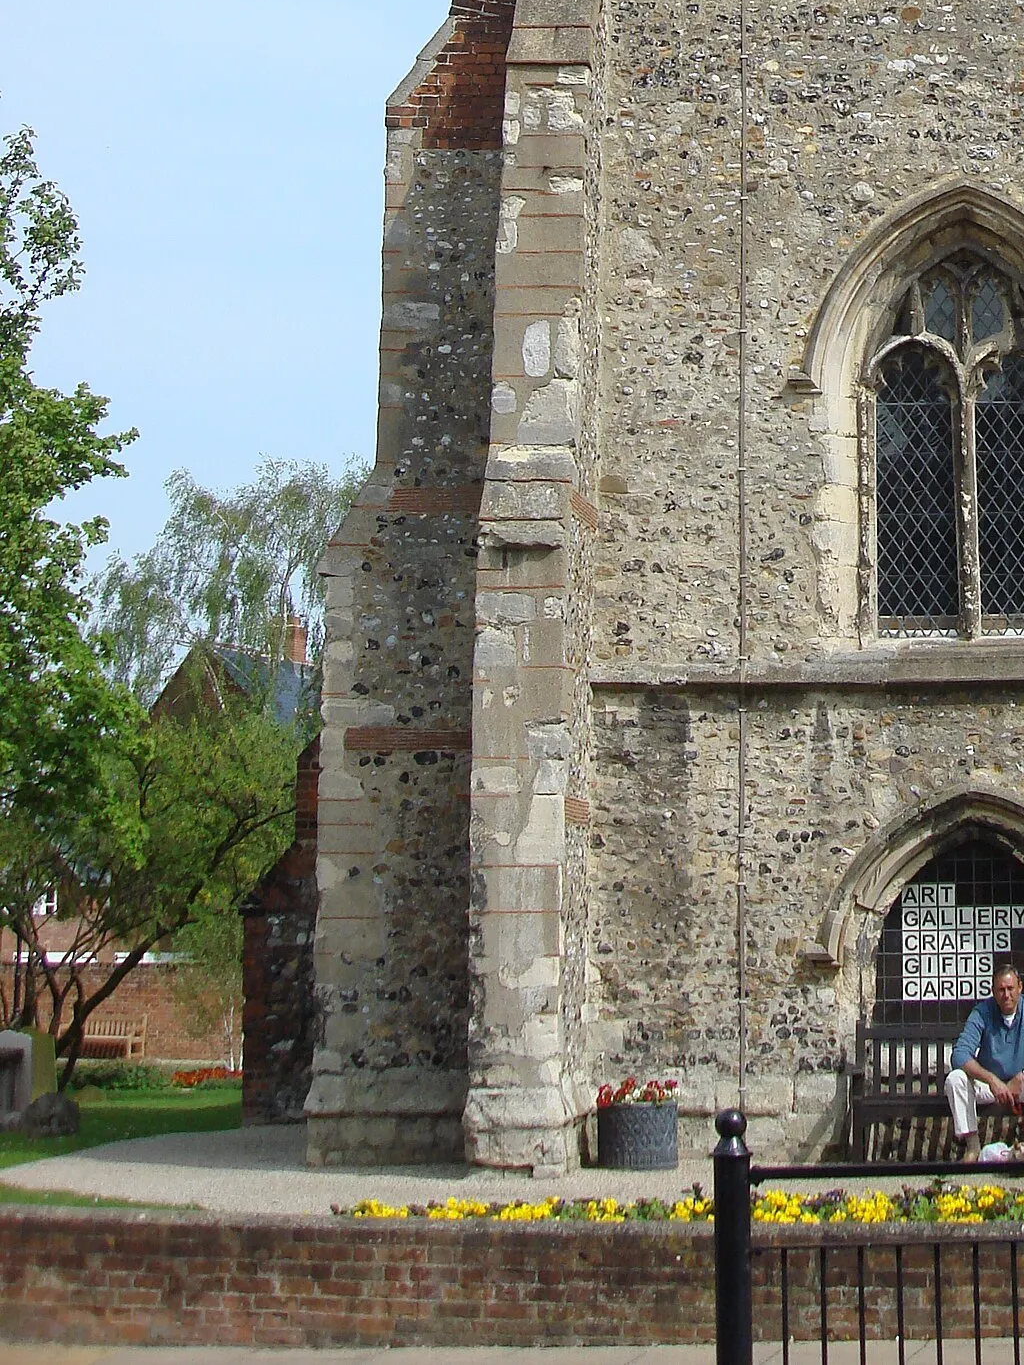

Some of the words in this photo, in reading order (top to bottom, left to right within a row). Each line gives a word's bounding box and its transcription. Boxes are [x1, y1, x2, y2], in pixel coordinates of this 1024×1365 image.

[903, 887, 953, 904] ART
[904, 933, 1009, 951] CRAFTS
[904, 957, 991, 974] GIFTS
[904, 981, 992, 998] CARDS
